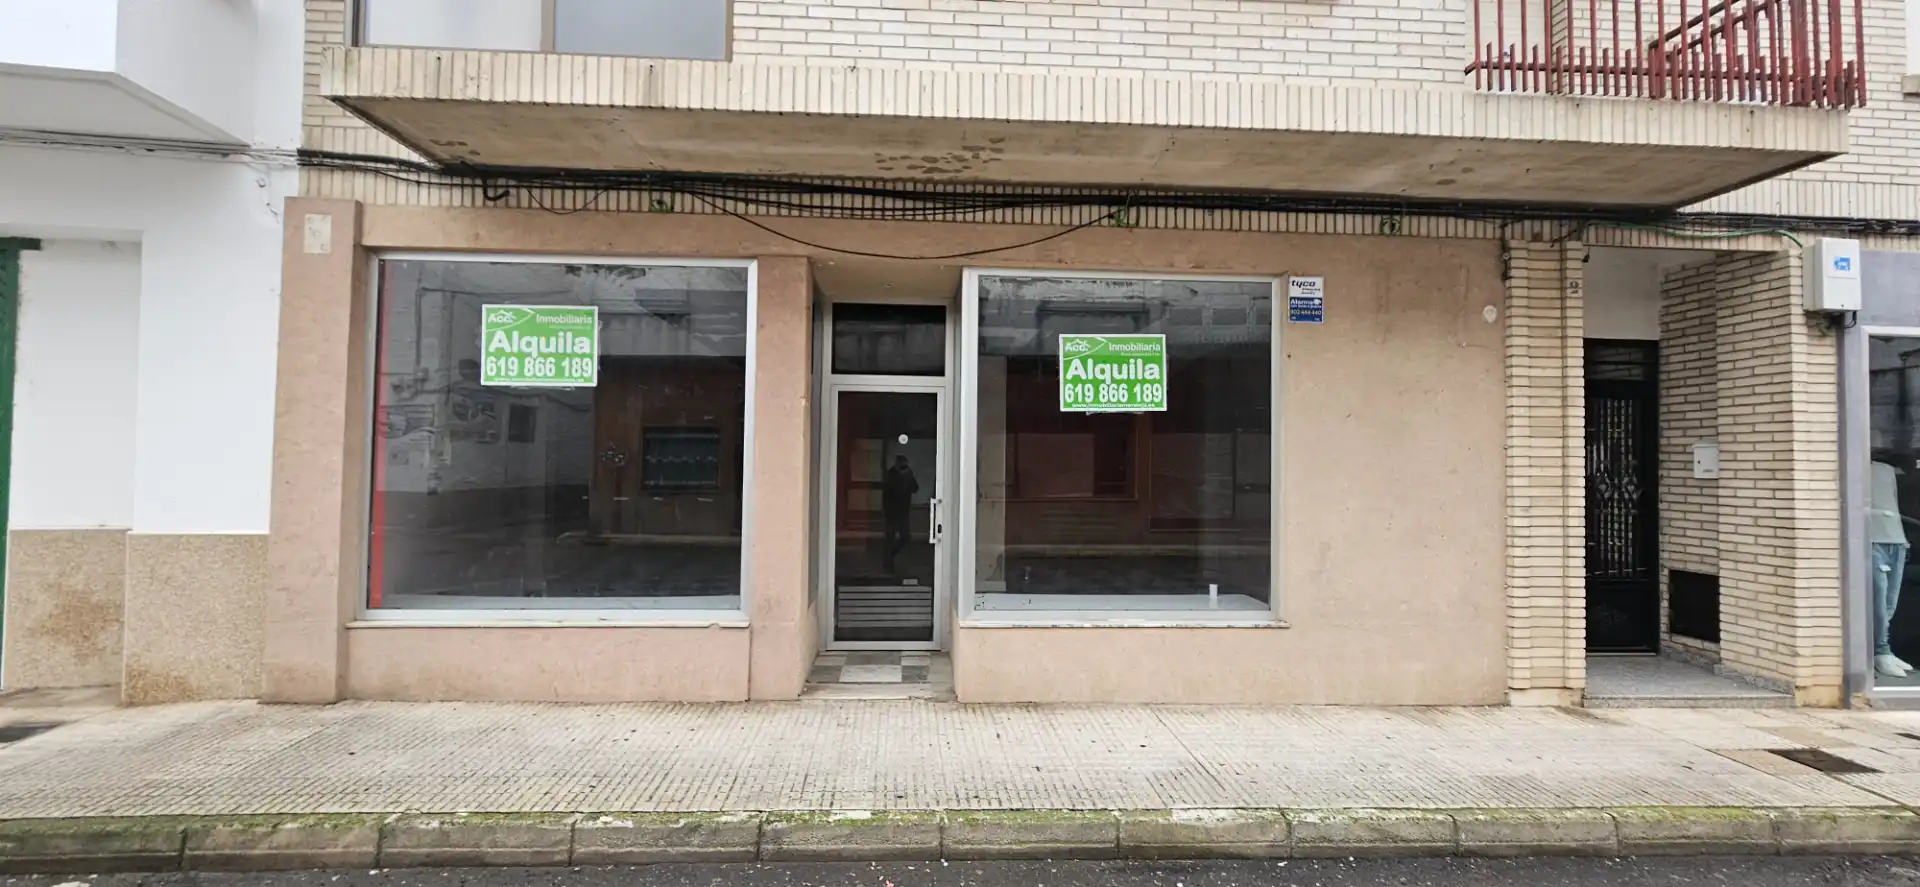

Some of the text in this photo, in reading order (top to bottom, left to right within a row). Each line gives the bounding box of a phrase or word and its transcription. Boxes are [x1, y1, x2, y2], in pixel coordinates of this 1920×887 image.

[1292, 280, 1315, 288] tyco
[536, 314, 592, 324] Inmobiliaria
[488, 330, 591, 358] Alquila
[1109, 342, 1161, 352] Inmobiliaria
[486, 356, 593, 378] 619 866 189
[1066, 358, 1161, 385] Alquila
[1064, 383, 1163, 403] 619 866 189
